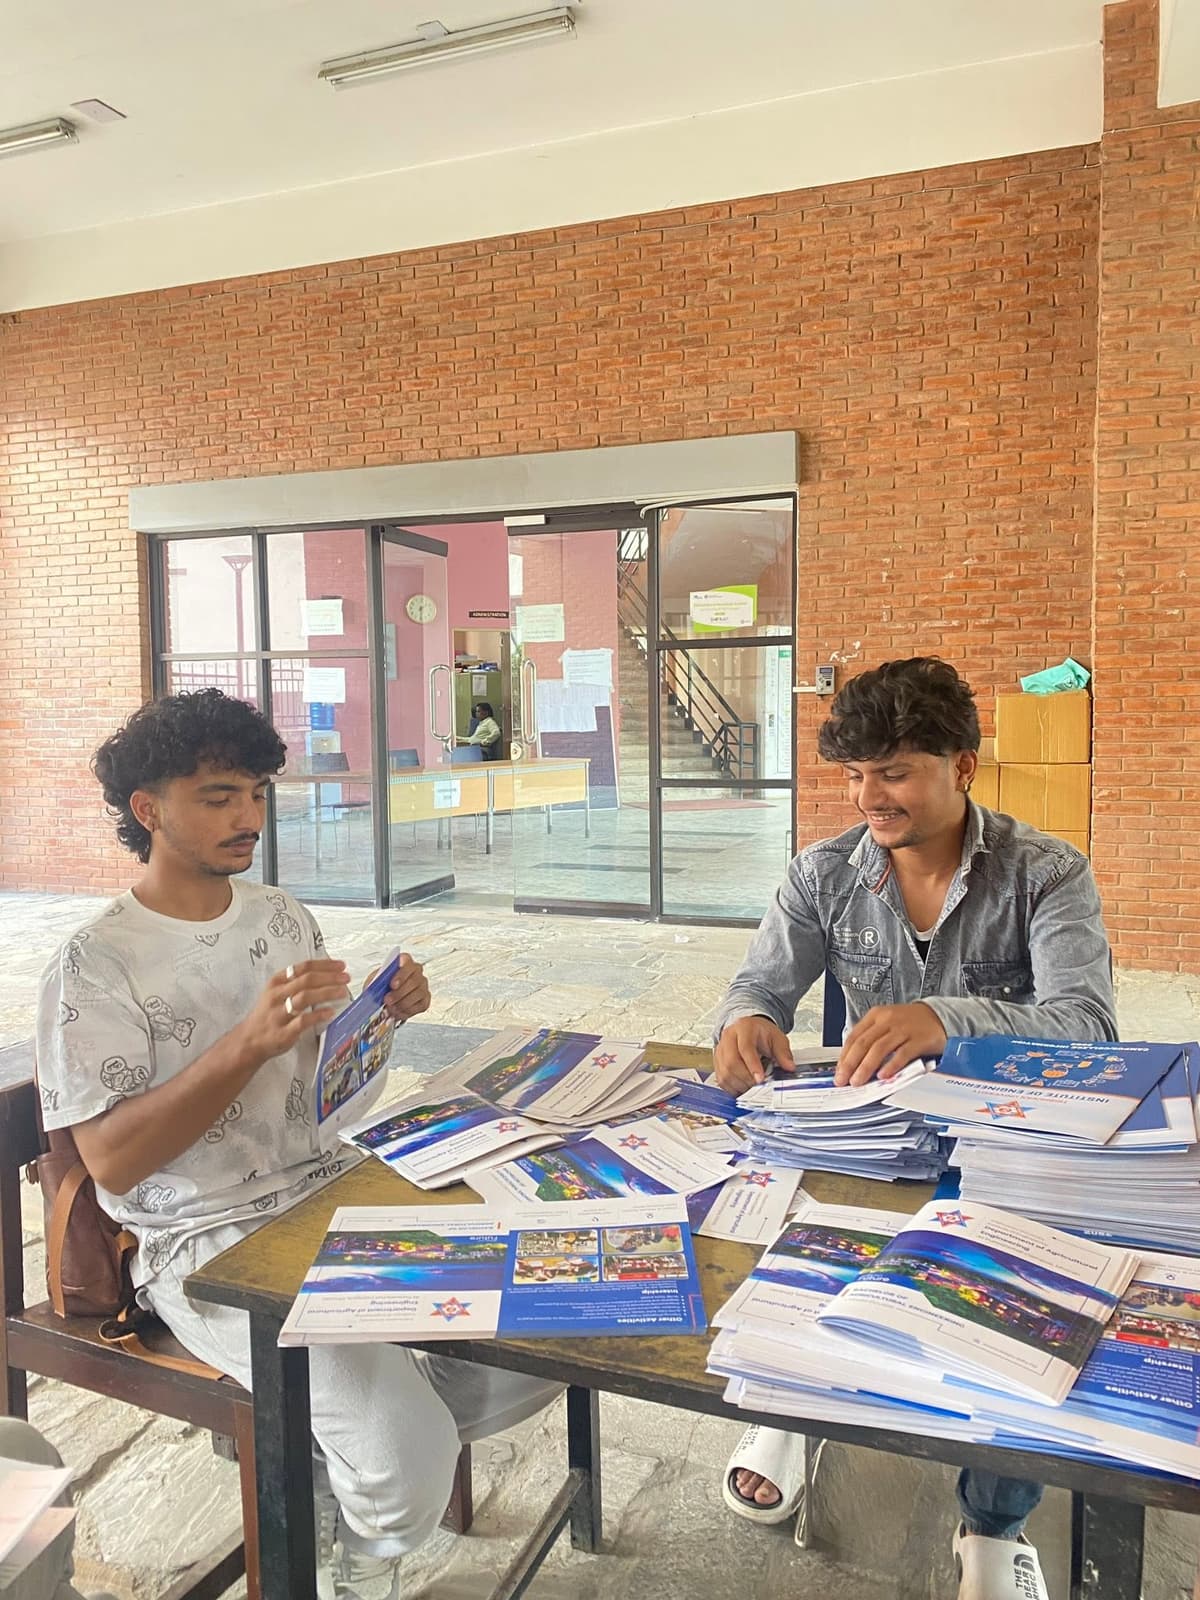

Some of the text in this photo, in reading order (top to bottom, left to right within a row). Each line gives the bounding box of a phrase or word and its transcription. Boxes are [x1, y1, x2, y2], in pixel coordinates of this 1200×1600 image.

[865, 931, 875, 945] R
[946, 1079, 1026, 1095] ENGINEERING
[1049, 1091, 1110, 1104] INSTITUTE
[1105, 1385, 1194, 1409] Other Activities
[1014, 1567, 1023, 1589] THE
